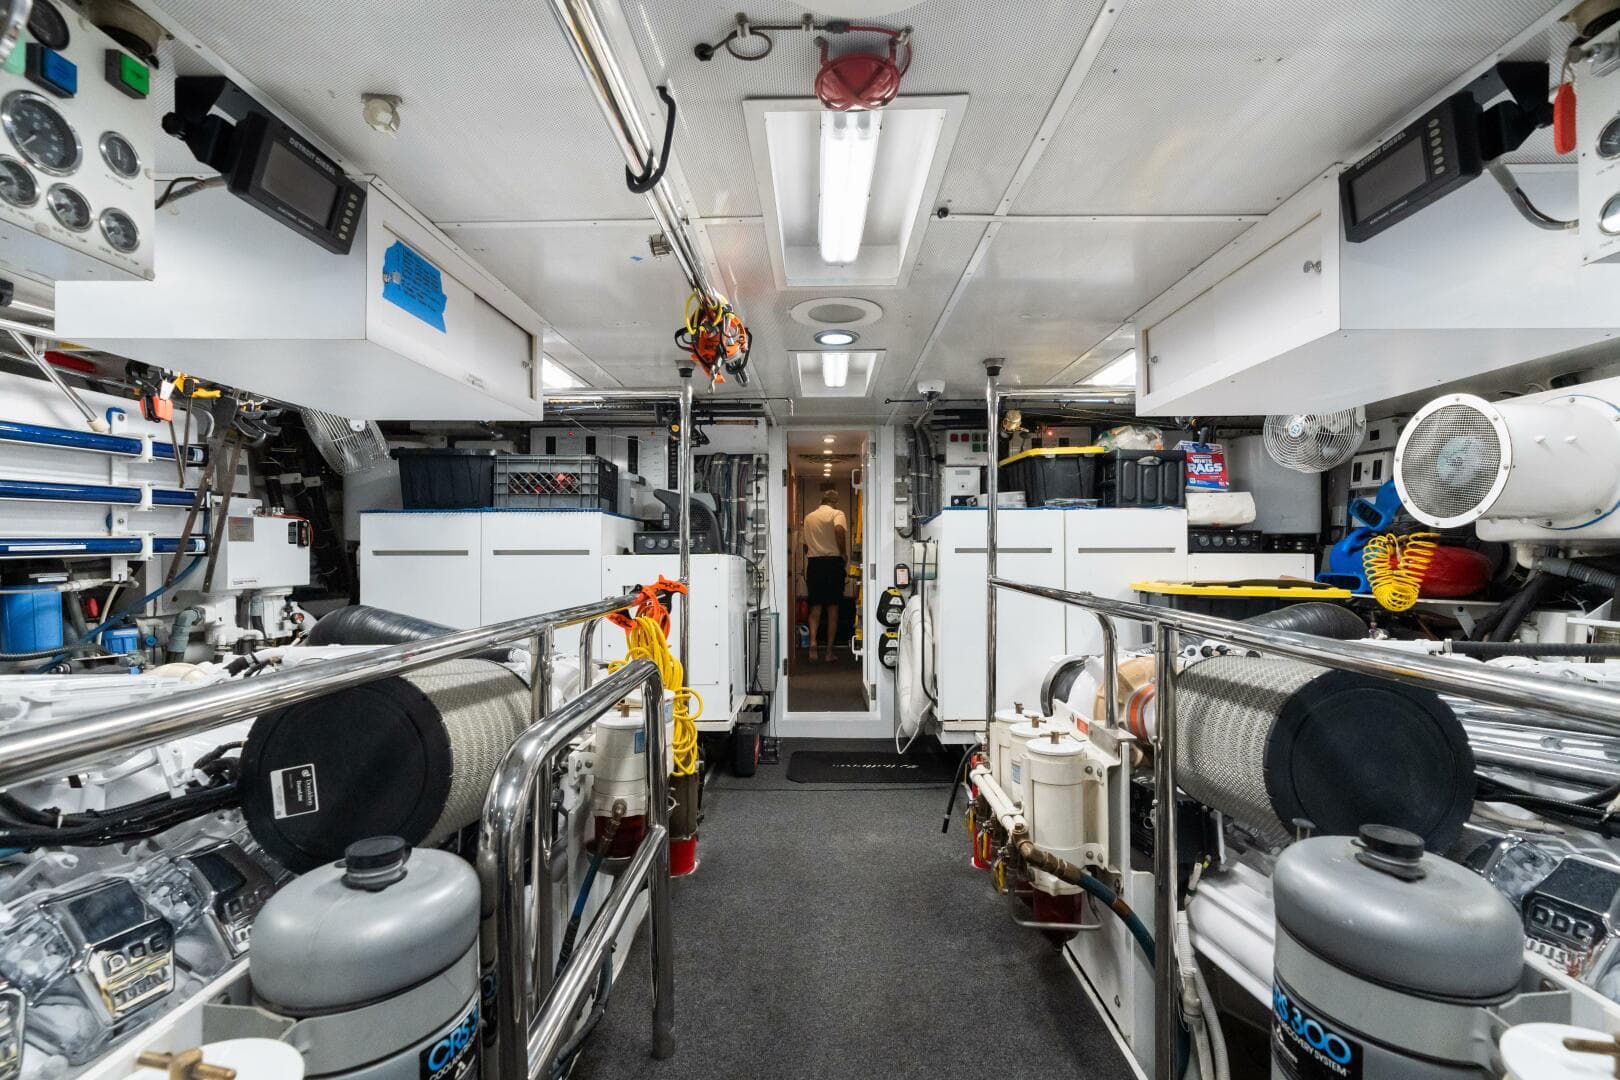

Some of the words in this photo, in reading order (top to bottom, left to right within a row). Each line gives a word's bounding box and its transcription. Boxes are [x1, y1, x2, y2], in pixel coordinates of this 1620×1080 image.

[1187, 463, 1223, 475] RAGS
[1291, 1006, 1352, 1065] 300
[1314, 1050, 1347, 1077] SYSTEM
